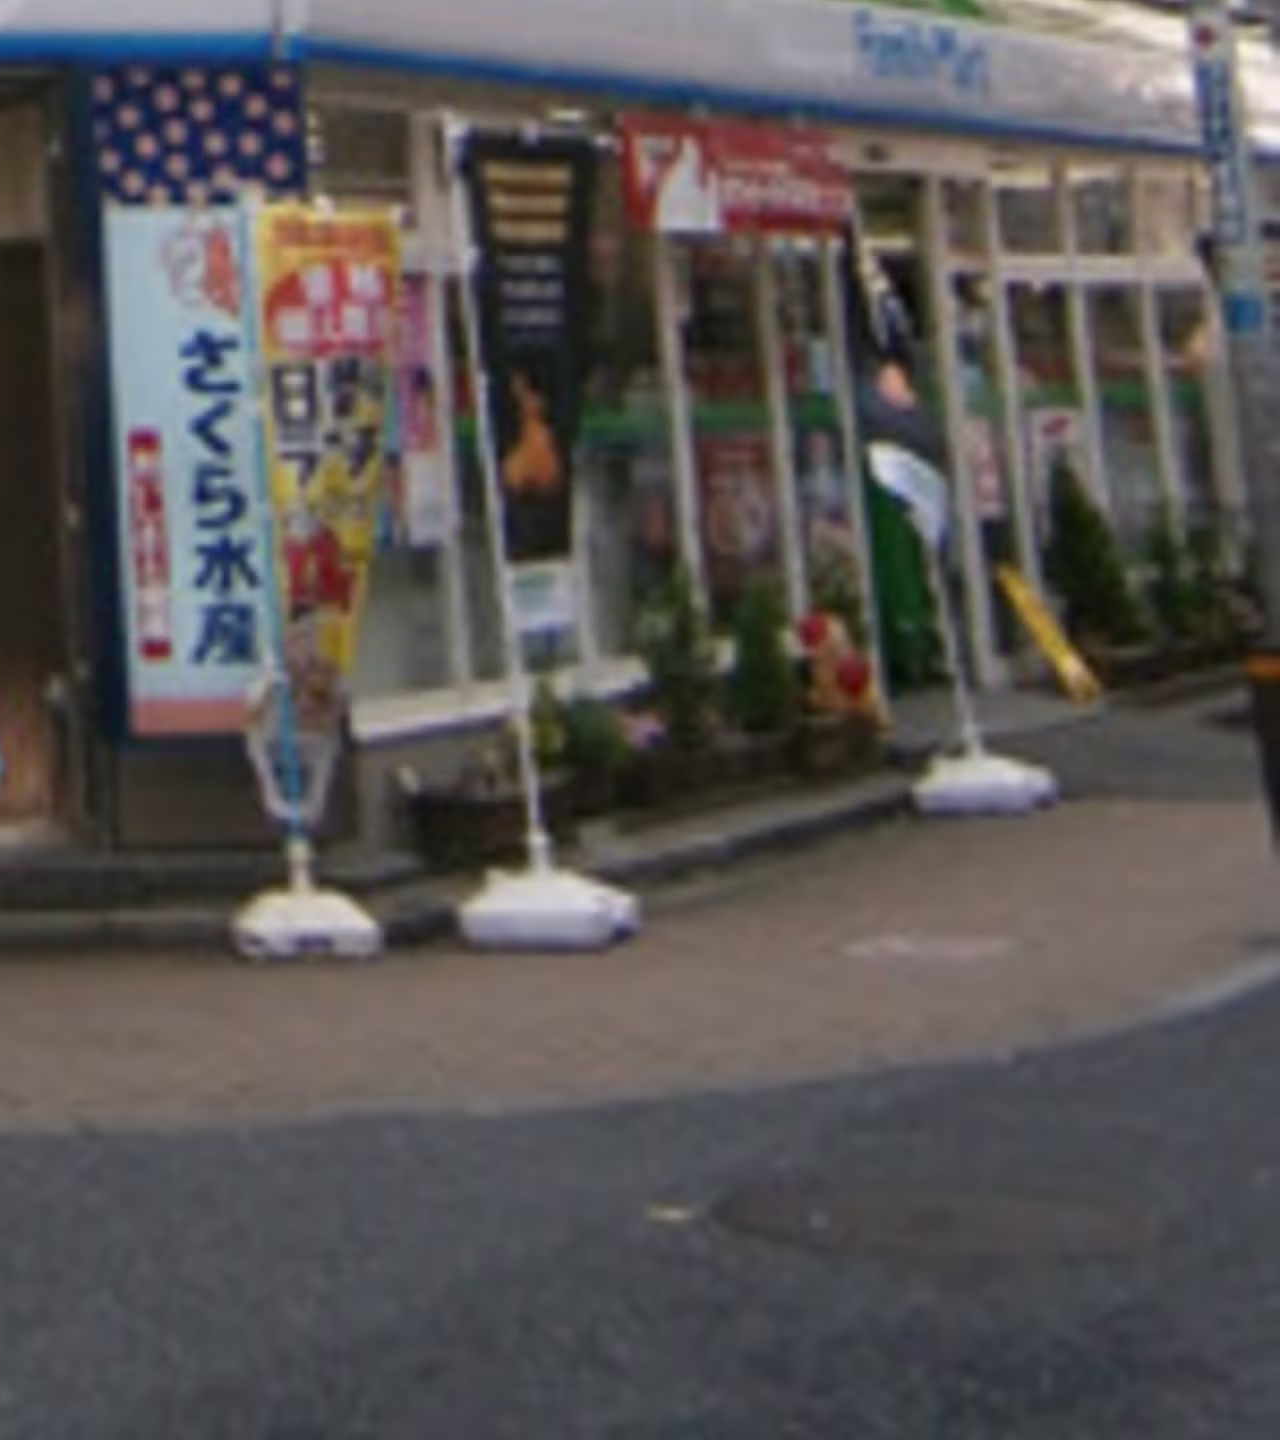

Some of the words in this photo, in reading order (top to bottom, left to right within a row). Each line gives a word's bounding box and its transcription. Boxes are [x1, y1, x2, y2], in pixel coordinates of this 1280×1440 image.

[179, 329, 259, 666] さくら水産
